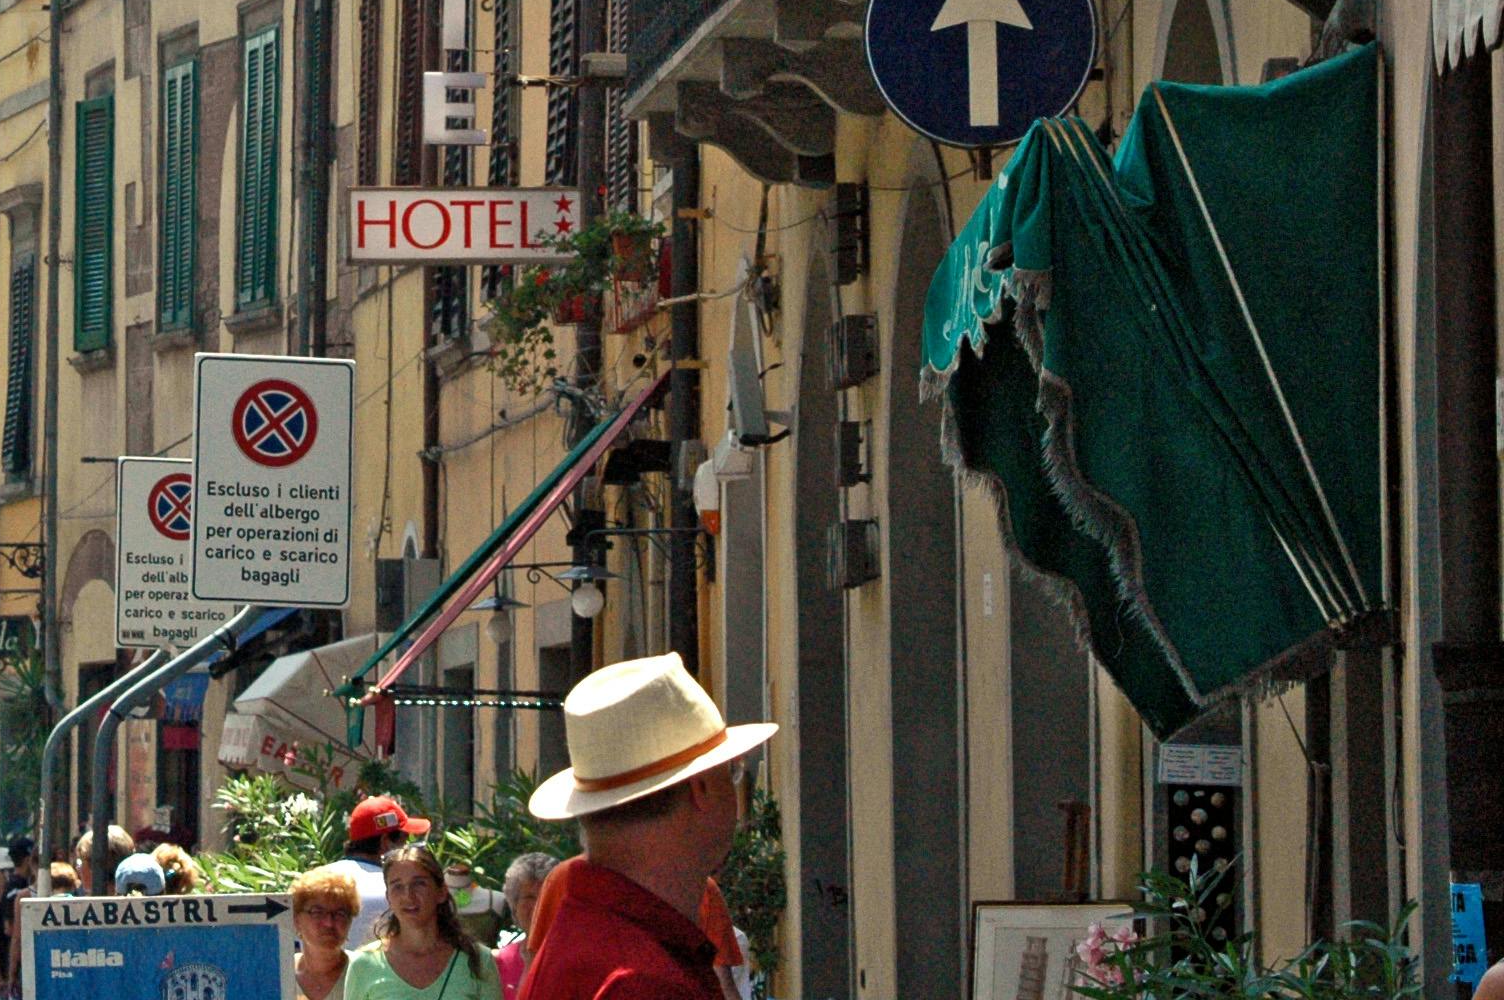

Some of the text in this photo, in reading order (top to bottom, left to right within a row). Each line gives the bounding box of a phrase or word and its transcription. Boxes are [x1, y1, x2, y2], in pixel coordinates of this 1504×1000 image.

[357, 199, 542, 250] HOTEL
[207, 481, 340, 500] Escluso i clienti
[224, 502, 320, 524] dell'albergo
[206, 526, 338, 543] per operazioni di
[126, 552, 174, 565] Escluso
[205, 545, 338, 564] carico e scarico
[141, 571, 189, 583] dell'alb
[241, 566, 300, 586] bagagli
[125, 590, 189, 601] per operaz
[124, 607, 226, 621] carico e scarico
[153, 625, 198, 640] bagagli
[41, 899, 219, 927] ALABASTRI
[51, 948, 124, 968] Italia
